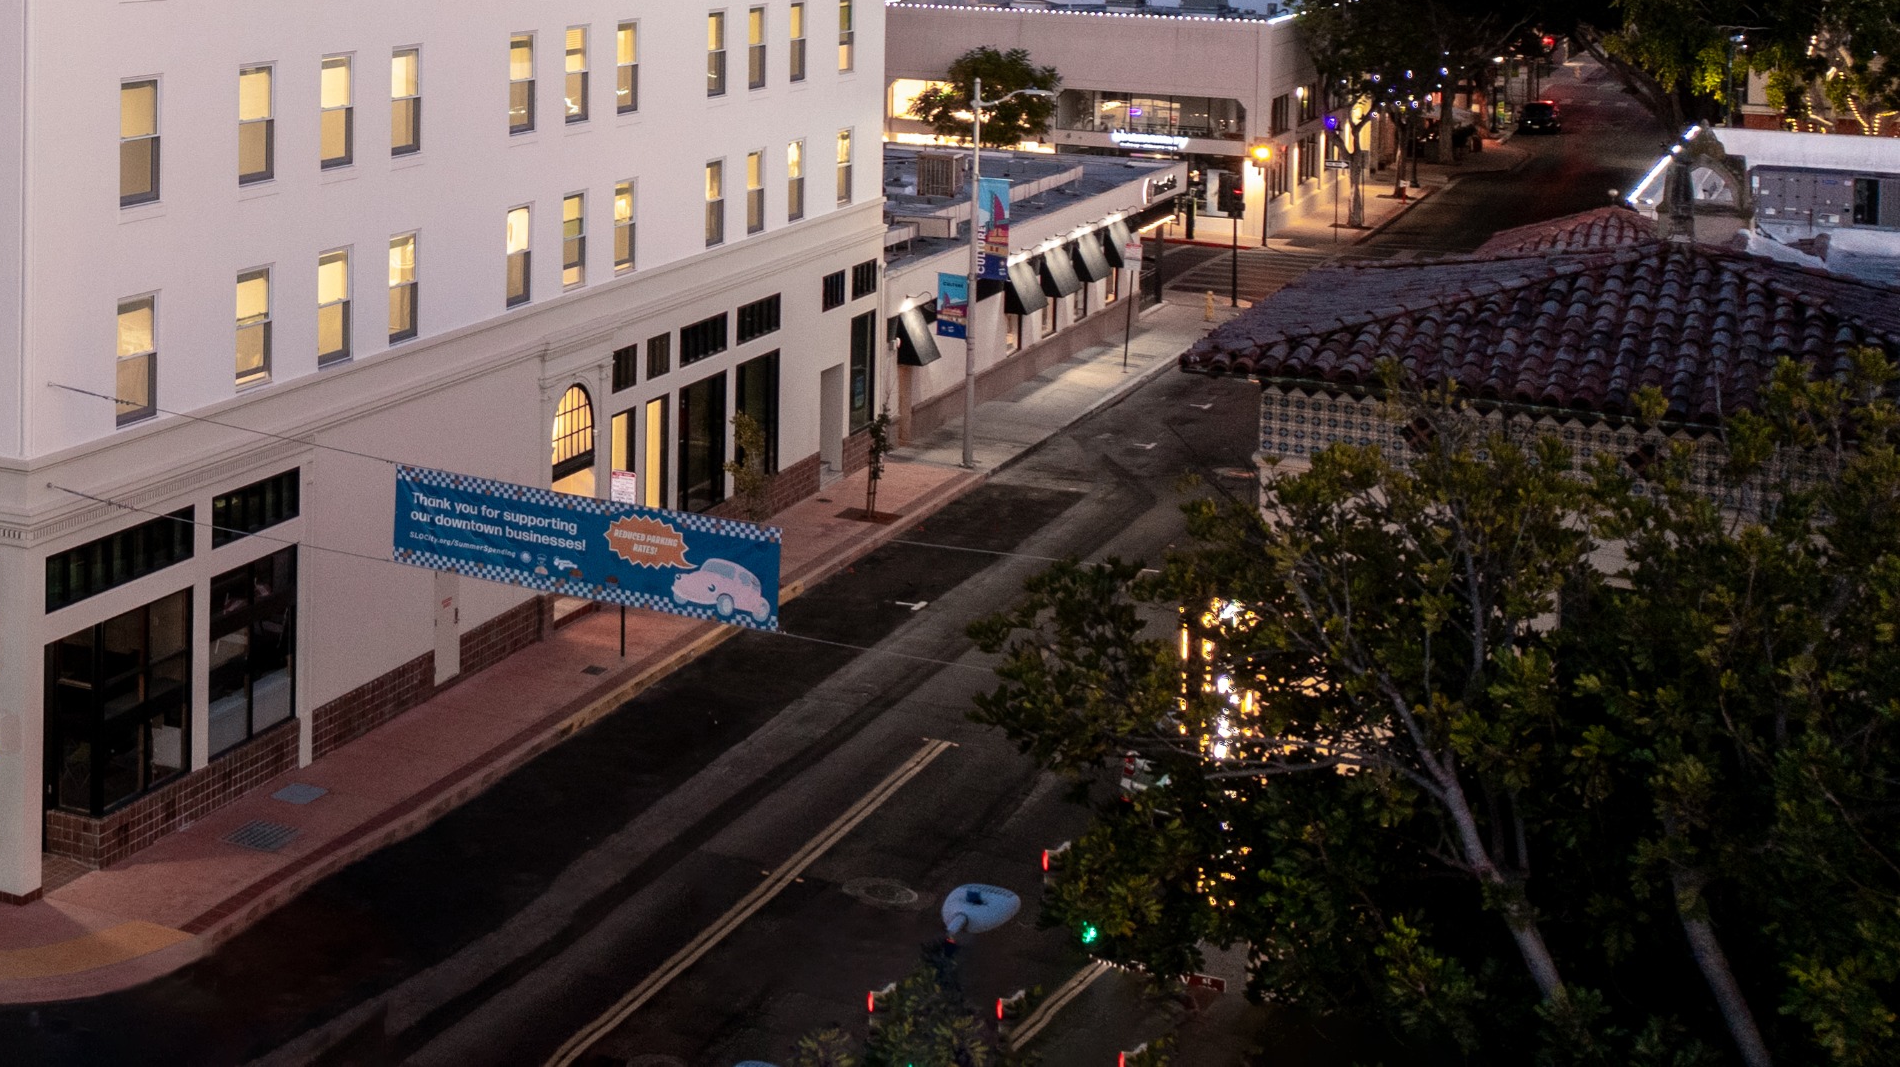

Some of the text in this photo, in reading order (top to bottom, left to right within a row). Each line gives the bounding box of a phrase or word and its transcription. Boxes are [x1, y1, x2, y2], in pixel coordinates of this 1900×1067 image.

[977, 225, 986, 275] CULTURE
[410, 511, 586, 551] our downtown businesses!
[412, 492, 577, 535] Thank you for supporting
[613, 529, 679, 547] REDUCED PARKING
[633, 543, 658, 555] RATES!
